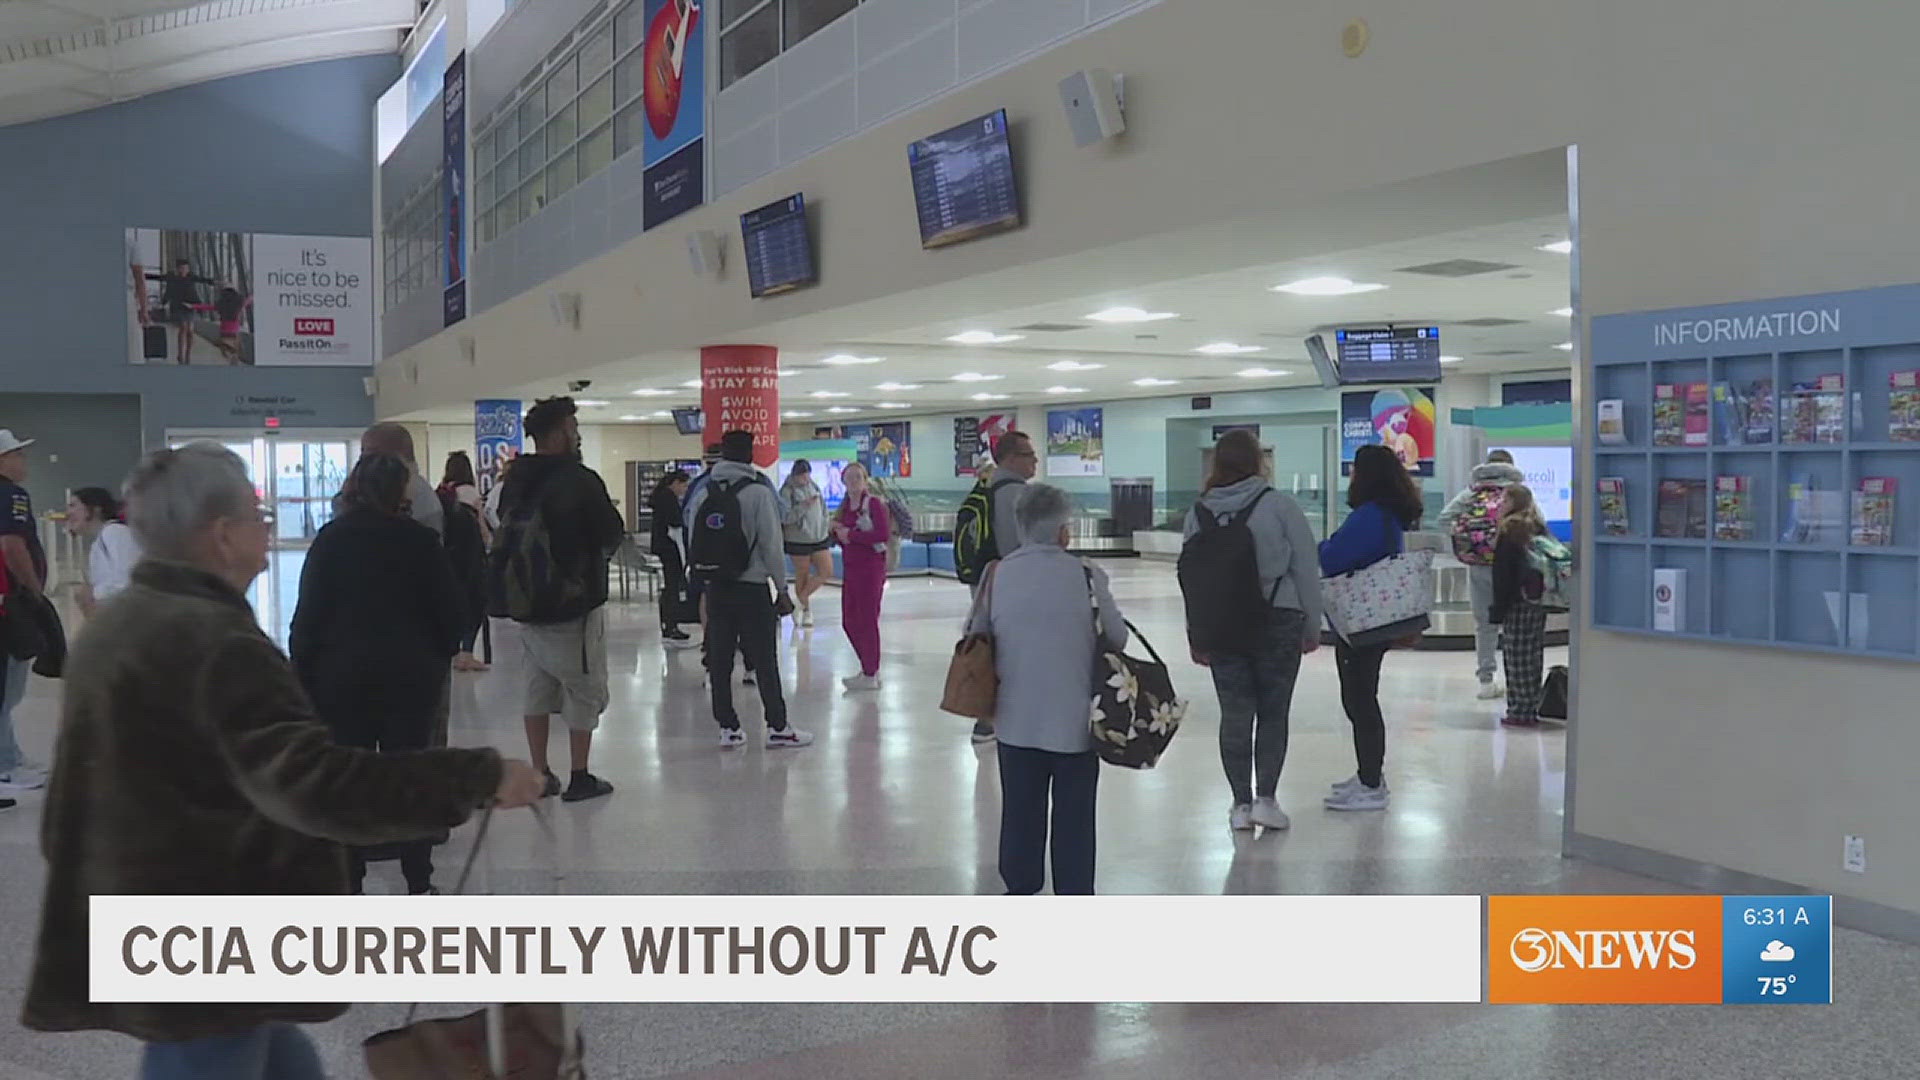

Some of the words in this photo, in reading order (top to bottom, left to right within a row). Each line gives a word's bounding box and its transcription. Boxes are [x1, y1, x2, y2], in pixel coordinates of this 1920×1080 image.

[301, 248, 327, 267] It's
[267, 271, 308, 288] nice
[311, 271, 331, 288] to
[335, 271, 360, 289] be
[279, 290, 352, 309] missed.
[298, 321, 331, 332] LOVE
[1654, 308, 1841, 347] INFORMATION
[709, 378, 746, 389] STAY
[721, 396, 762, 407] SWIM
[721, 409, 769, 421] AVOID
[753, 434, 776, 446] APE
